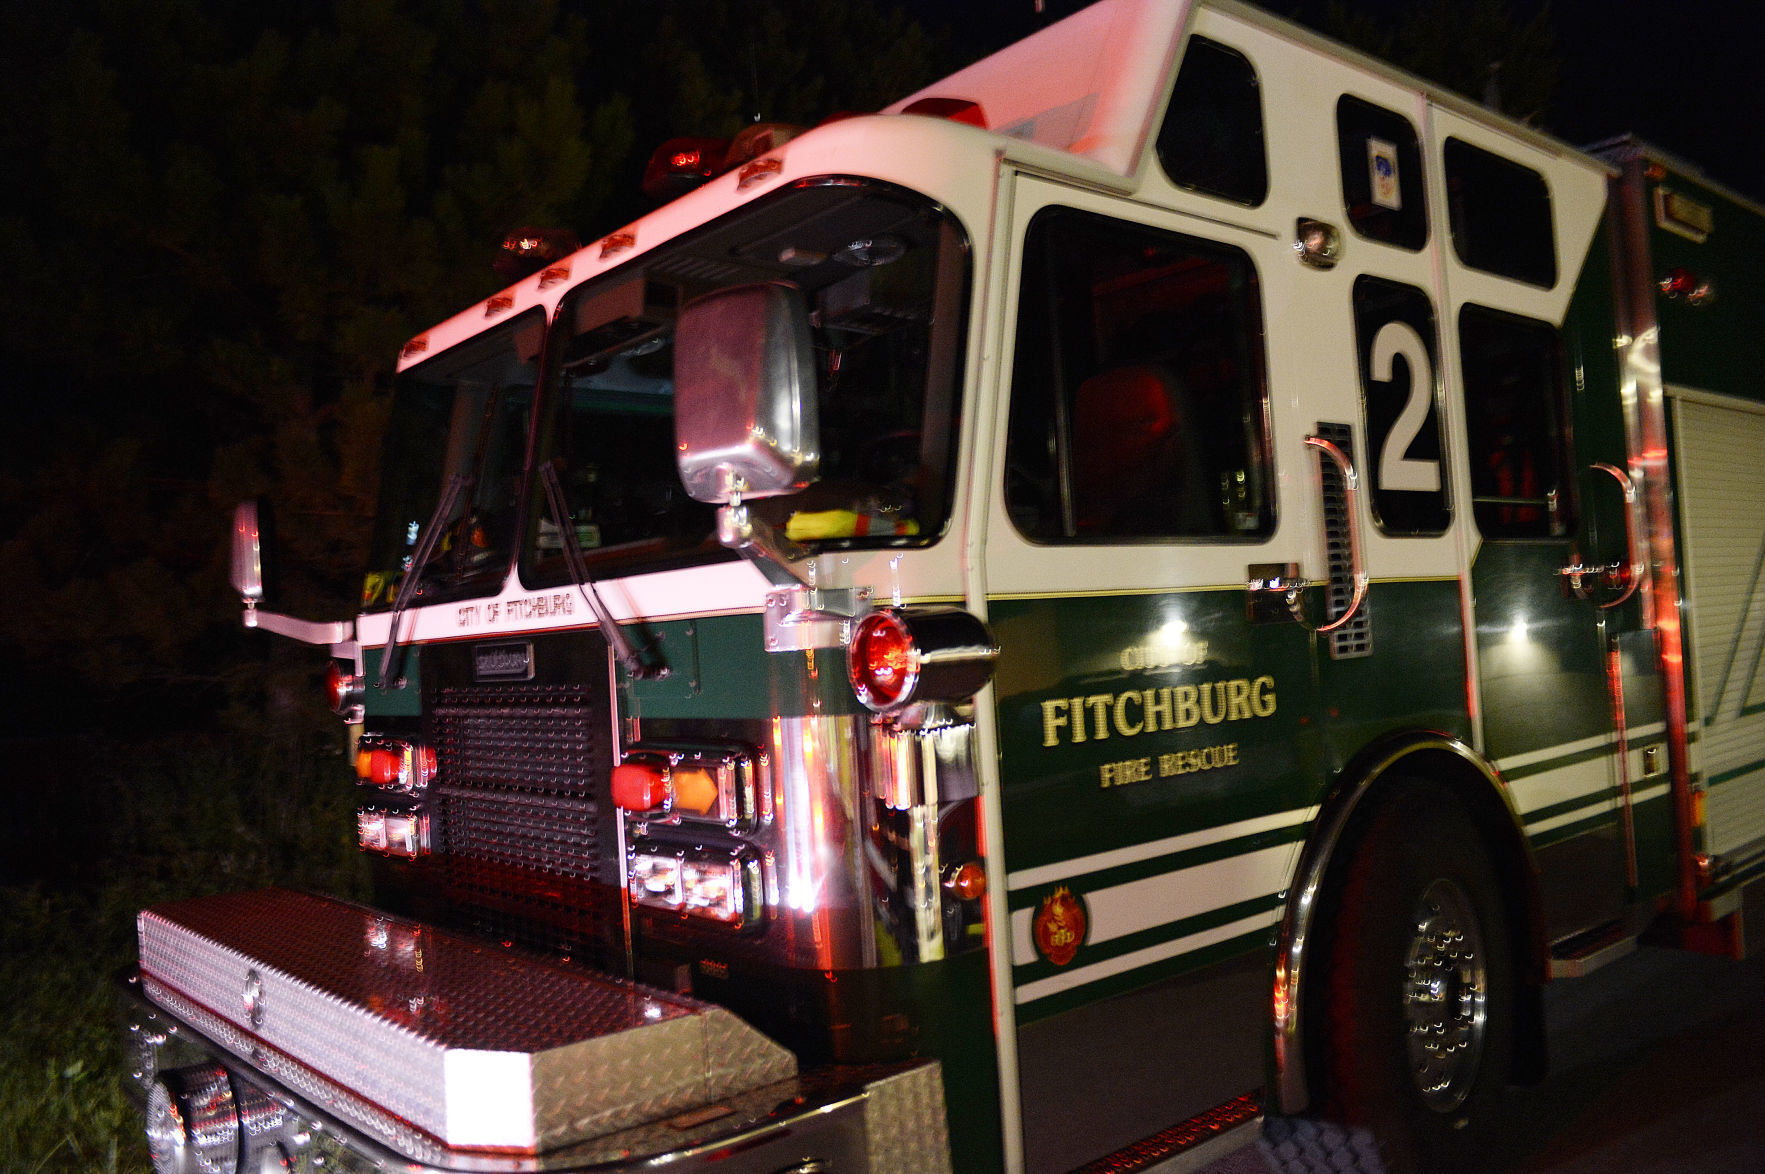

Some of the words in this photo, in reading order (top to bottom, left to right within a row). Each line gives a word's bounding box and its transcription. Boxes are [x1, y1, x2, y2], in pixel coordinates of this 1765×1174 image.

[1370, 321, 1441, 491] 2
[458, 605, 480, 627] CITY
[487, 603, 499, 623] OF
[507, 593, 575, 621] FITCHBURG
[1040, 675, 1277, 747] FITCHBURG
[1100, 757, 1152, 788] FIRE
[1158, 743, 1240, 777] RESCUE
